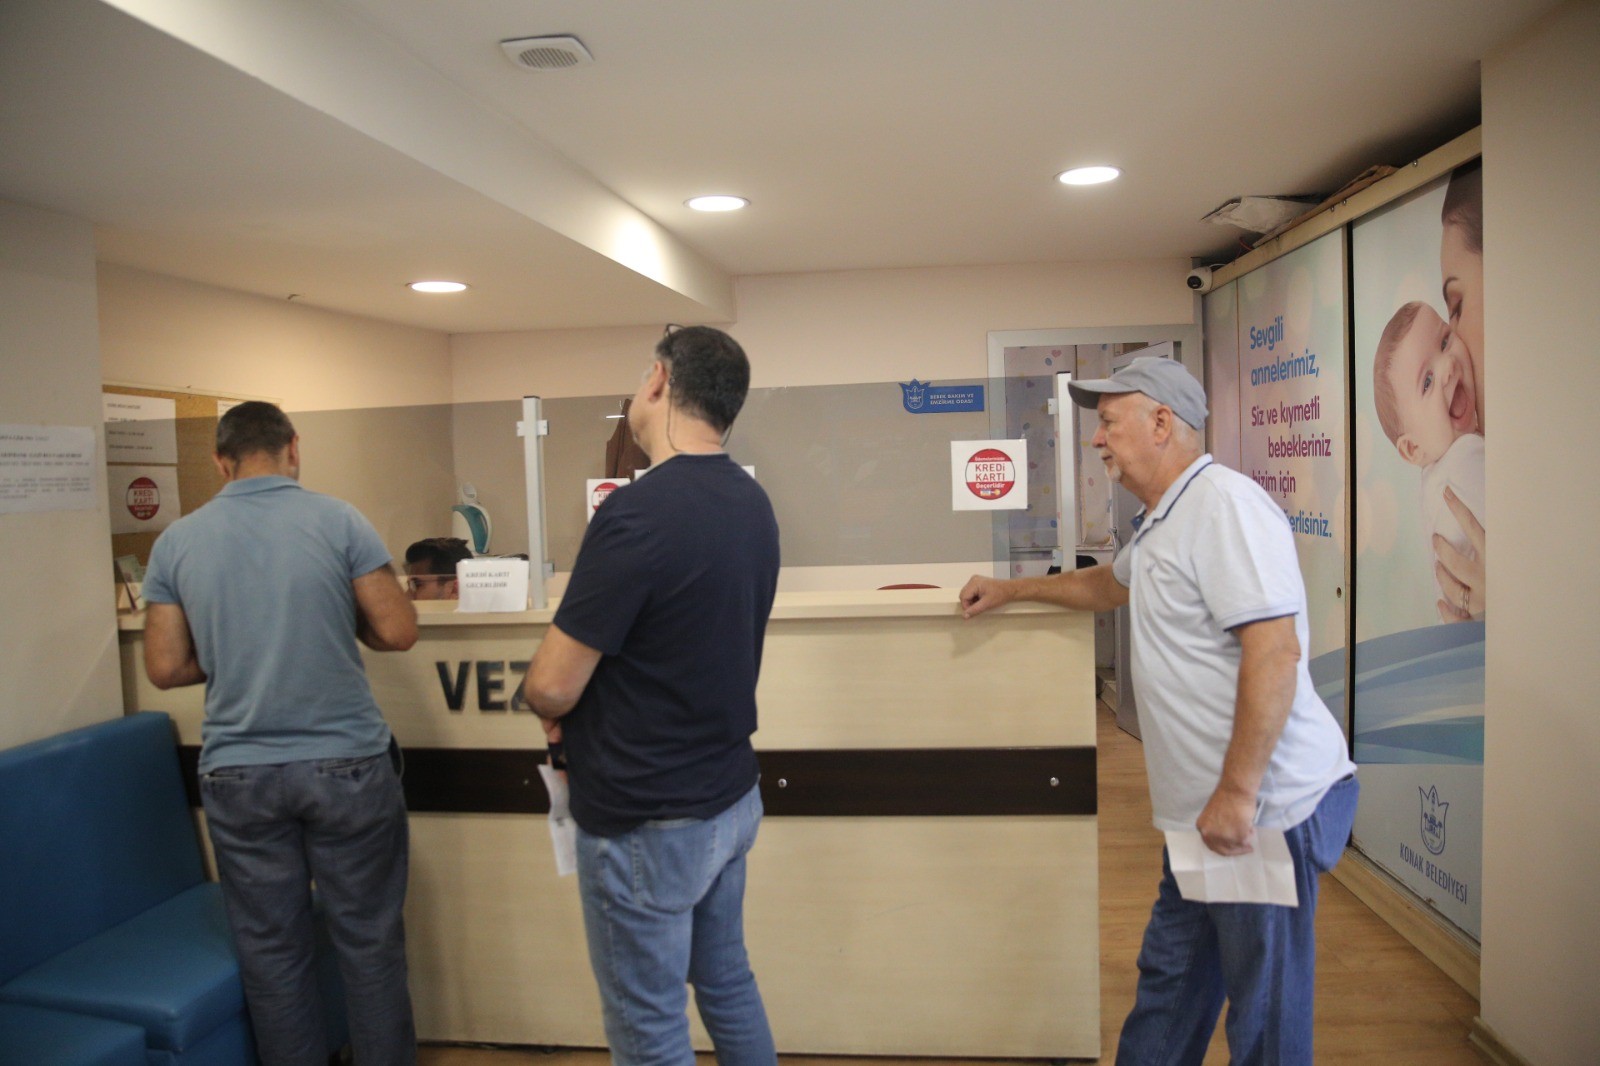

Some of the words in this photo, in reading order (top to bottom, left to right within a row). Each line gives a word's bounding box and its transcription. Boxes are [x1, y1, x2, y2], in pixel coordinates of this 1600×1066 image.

[1250, 315, 1284, 351] Sevgili
[1251, 348, 1319, 386] annelerimiz,
[1251, 405, 1264, 427] Siz
[1267, 407, 1278, 425] ve
[1280, 395, 1320, 429] kıymetli
[1268, 432, 1332, 458] bebekleriniz
[975, 473, 1005, 481] KARTI
[1279, 470, 1296, 498] için
[1284, 508, 1333, 538] erlisiniz.
[436, 661, 533, 713] VEZ
[1400, 842, 1424, 874] KONAK
[1425, 859, 1467, 905] BELEDİYESİ
